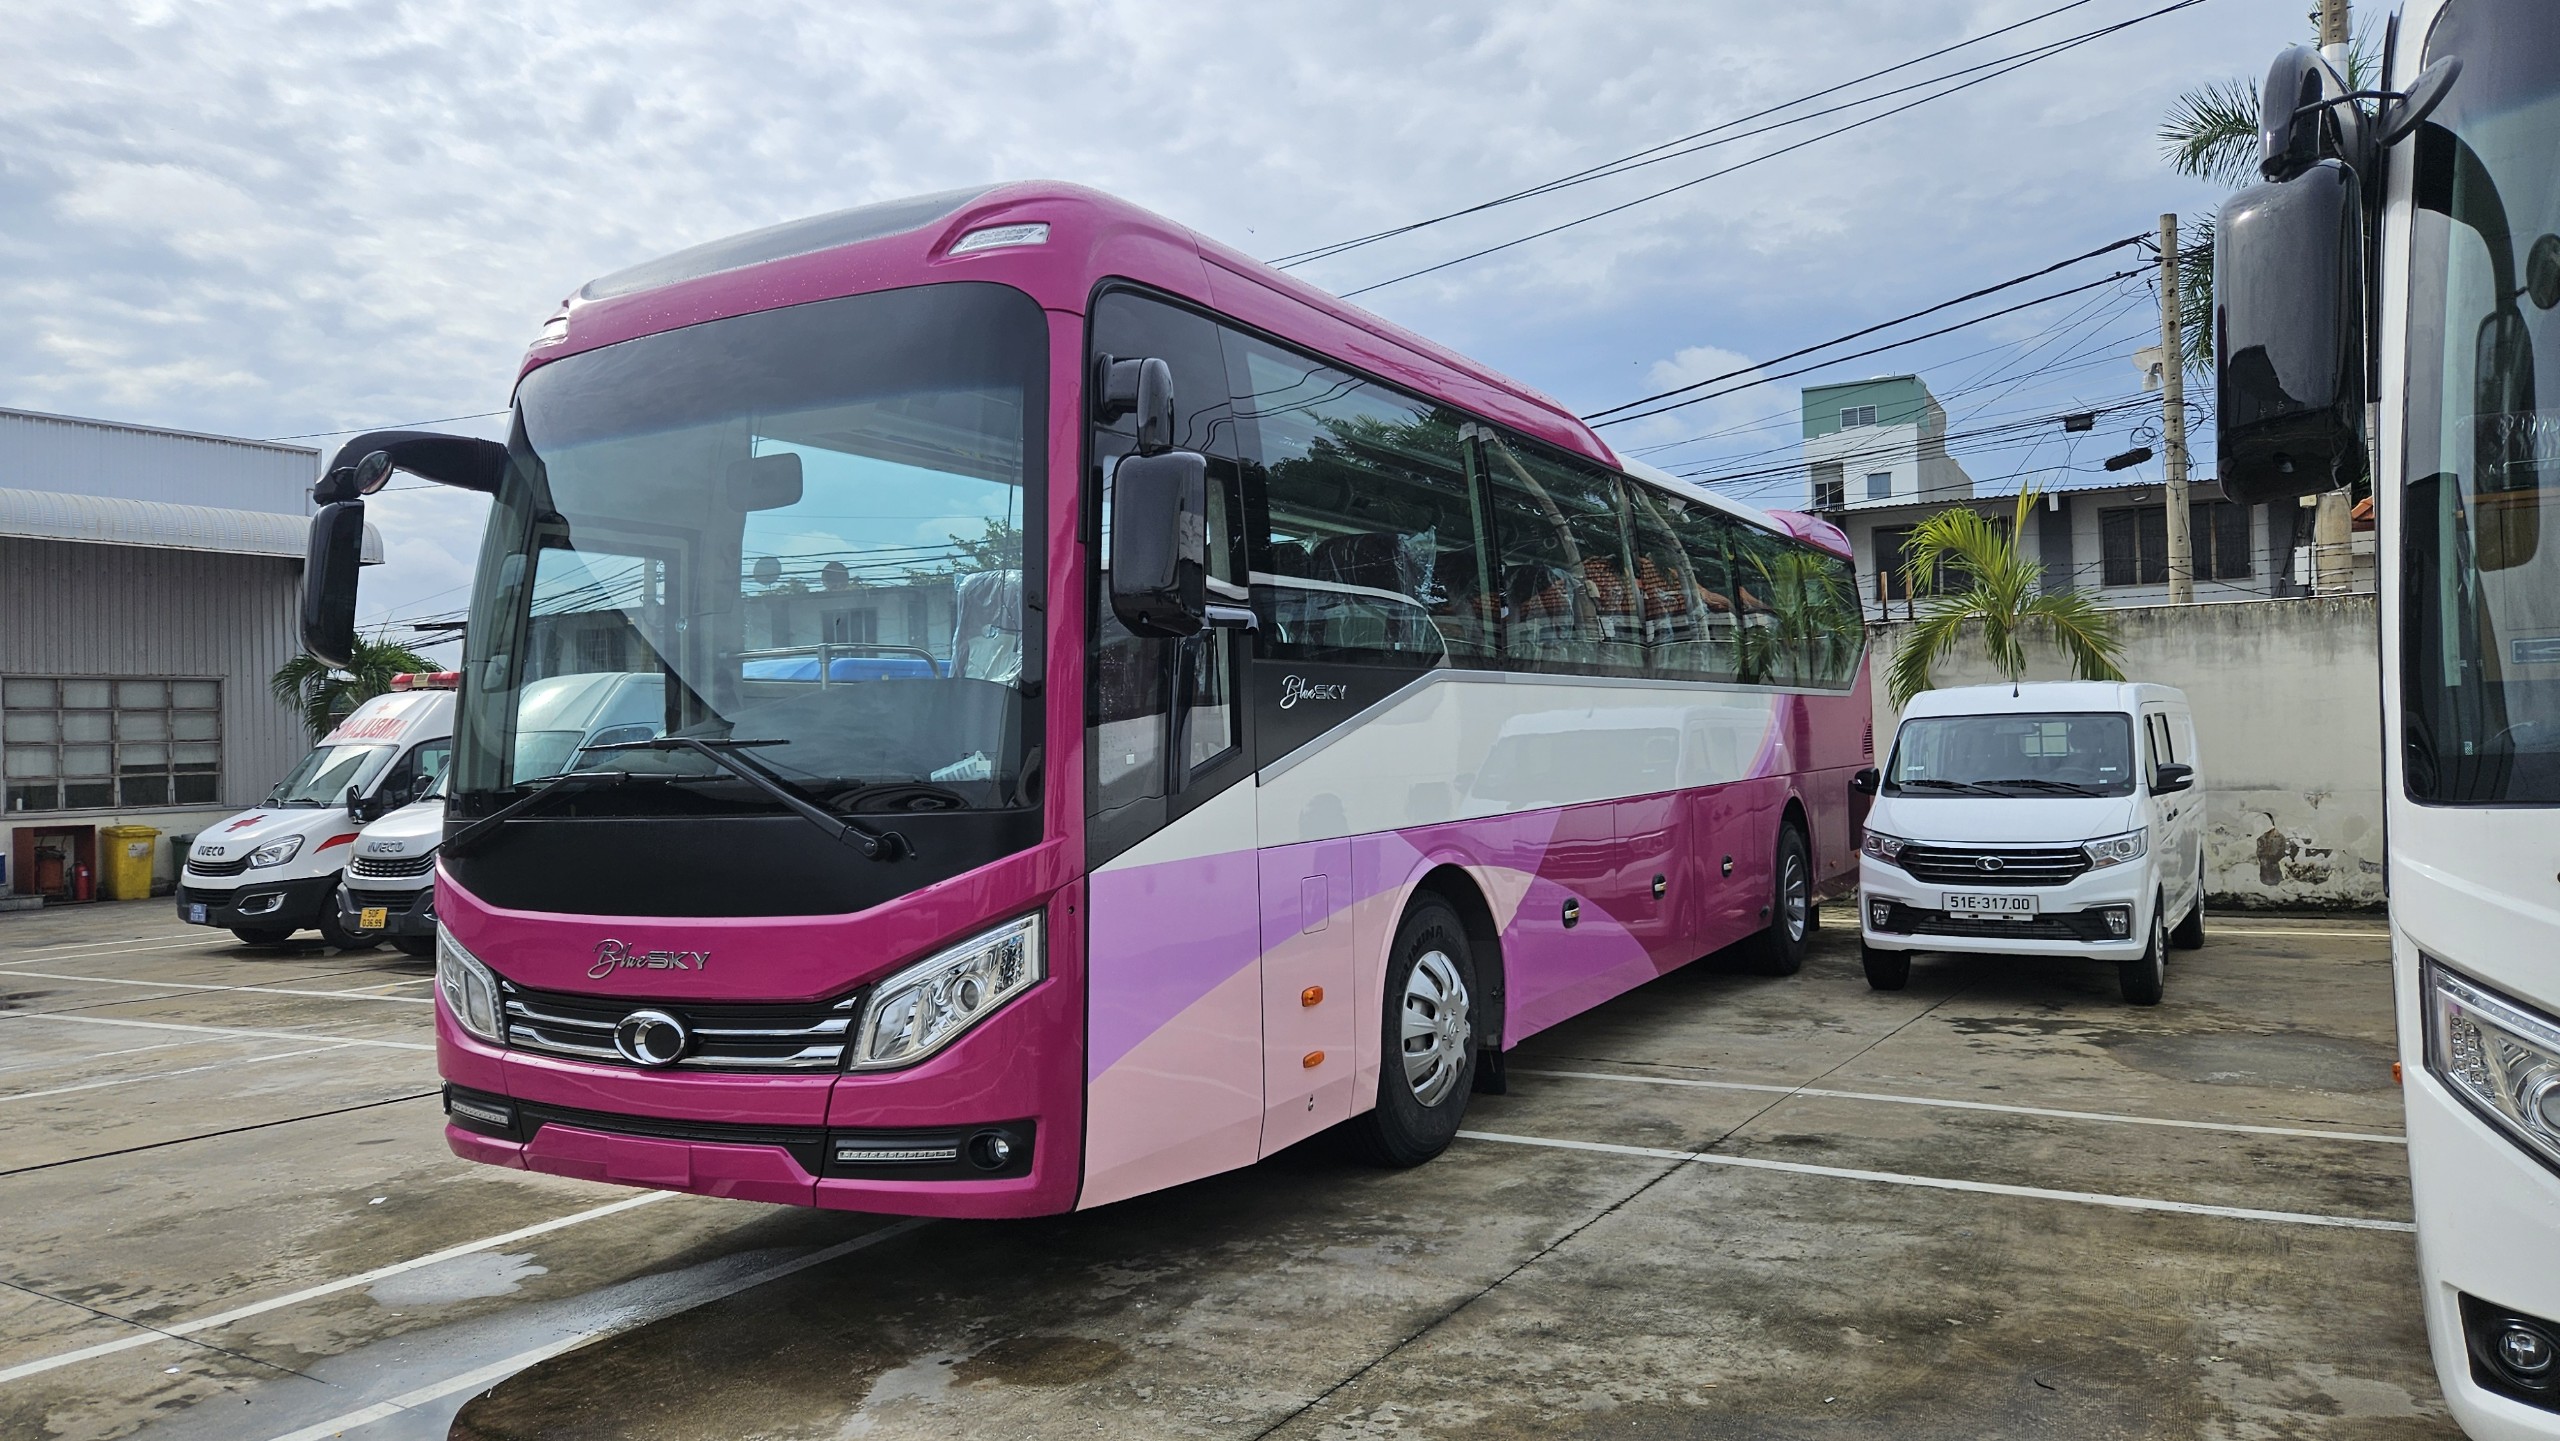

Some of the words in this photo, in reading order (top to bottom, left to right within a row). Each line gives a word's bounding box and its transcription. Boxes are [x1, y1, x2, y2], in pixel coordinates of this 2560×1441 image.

[197, 845, 225, 856] IVECO
[367, 840, 405, 853] IVECO
[1950, 896, 2030, 911] 51E-317.00
[587, 938, 711, 979] BlueSKY
